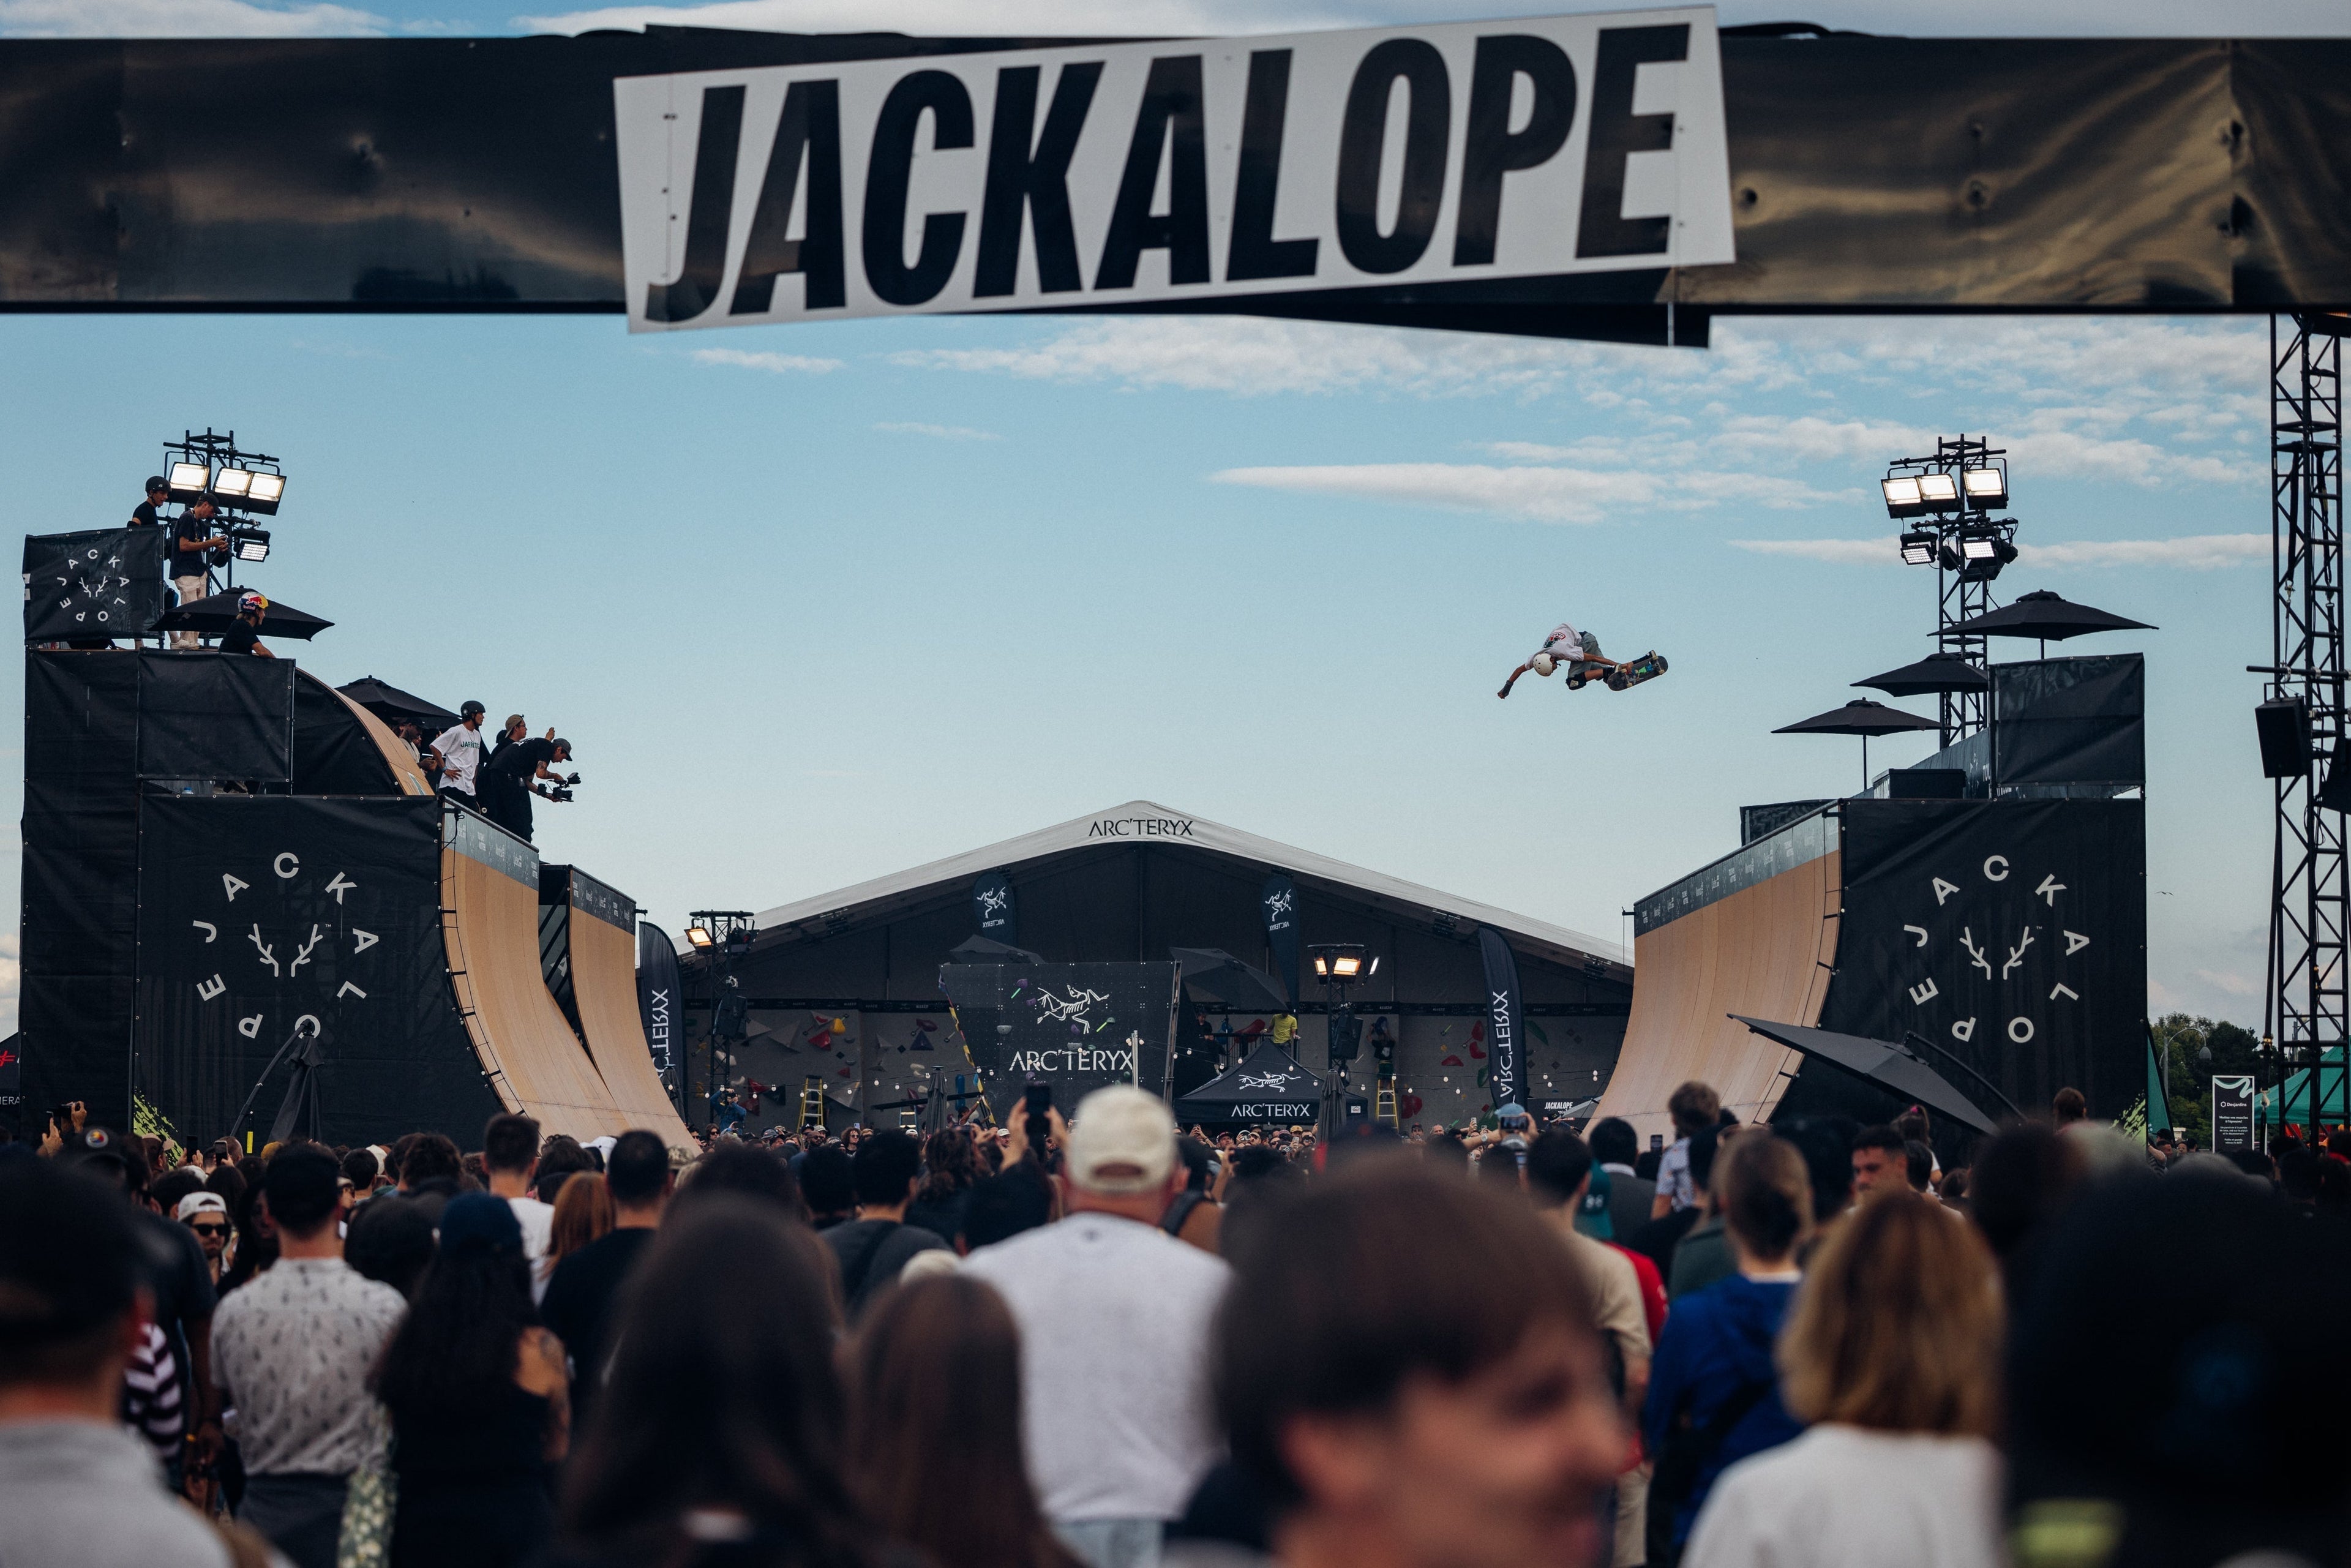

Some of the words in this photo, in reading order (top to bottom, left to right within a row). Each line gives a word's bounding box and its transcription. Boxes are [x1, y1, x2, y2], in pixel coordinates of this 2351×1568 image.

[644, 23, 1691, 324] JACKALOPE
[1089, 818, 1193, 836] ARC'TERYX
[1008, 1049, 1133, 1071] ARC'TERYX
[1231, 1103, 1310, 1117] ARC'TERYX
